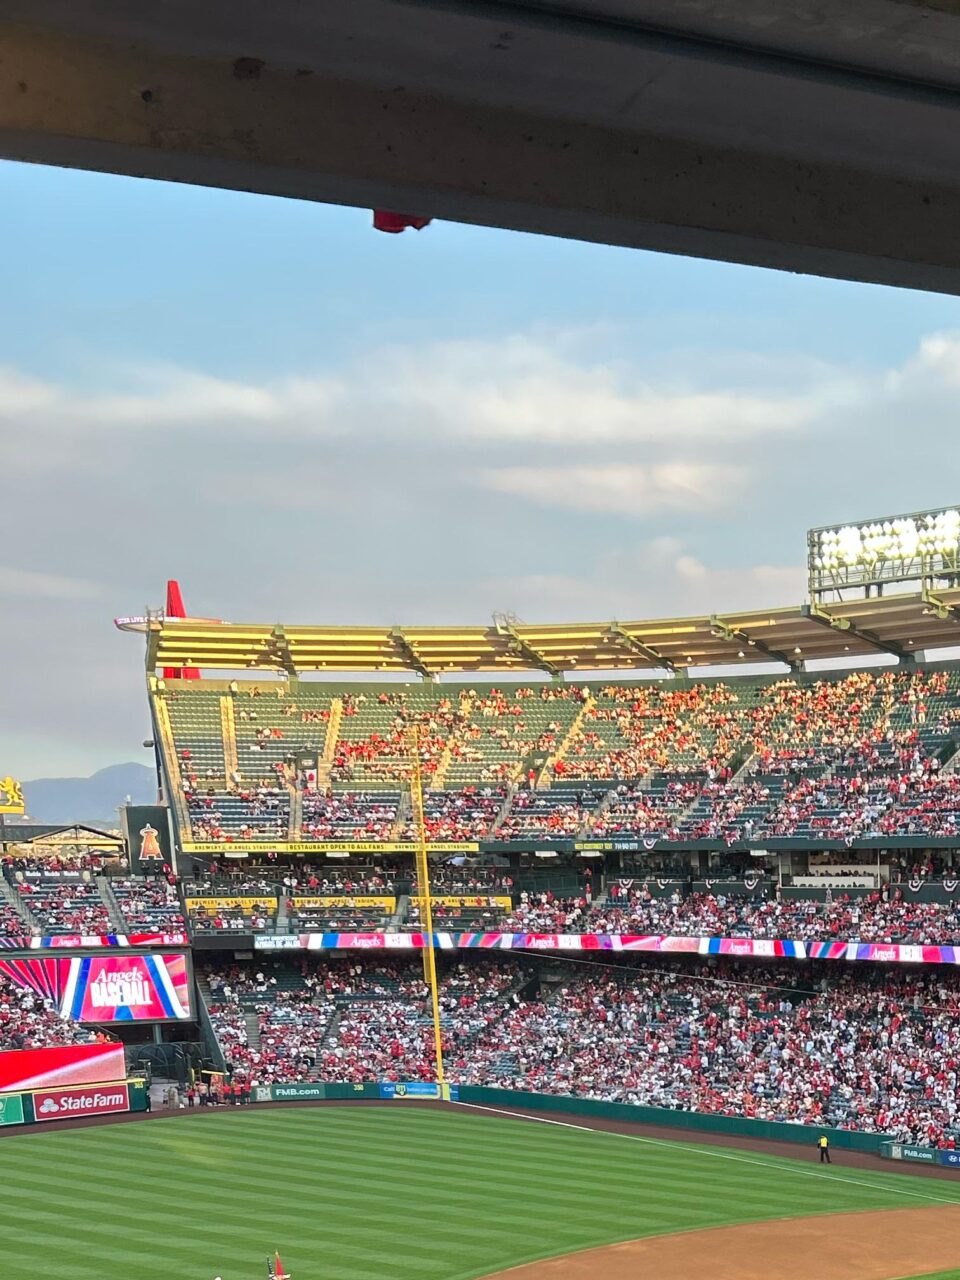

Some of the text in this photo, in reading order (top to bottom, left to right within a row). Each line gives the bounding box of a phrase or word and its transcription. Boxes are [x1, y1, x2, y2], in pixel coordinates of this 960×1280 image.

[351, 936, 381, 947] Angels
[527, 937, 555, 948] Angels
[728, 943, 750, 953] Angels
[871, 947, 897, 960] Angels
[95, 967, 144, 983] Angels
[90, 981, 152, 1007] BASEBALL
[275, 1088, 320, 1096] FMB.com
[904, 1151, 932, 1160] FMB.com
